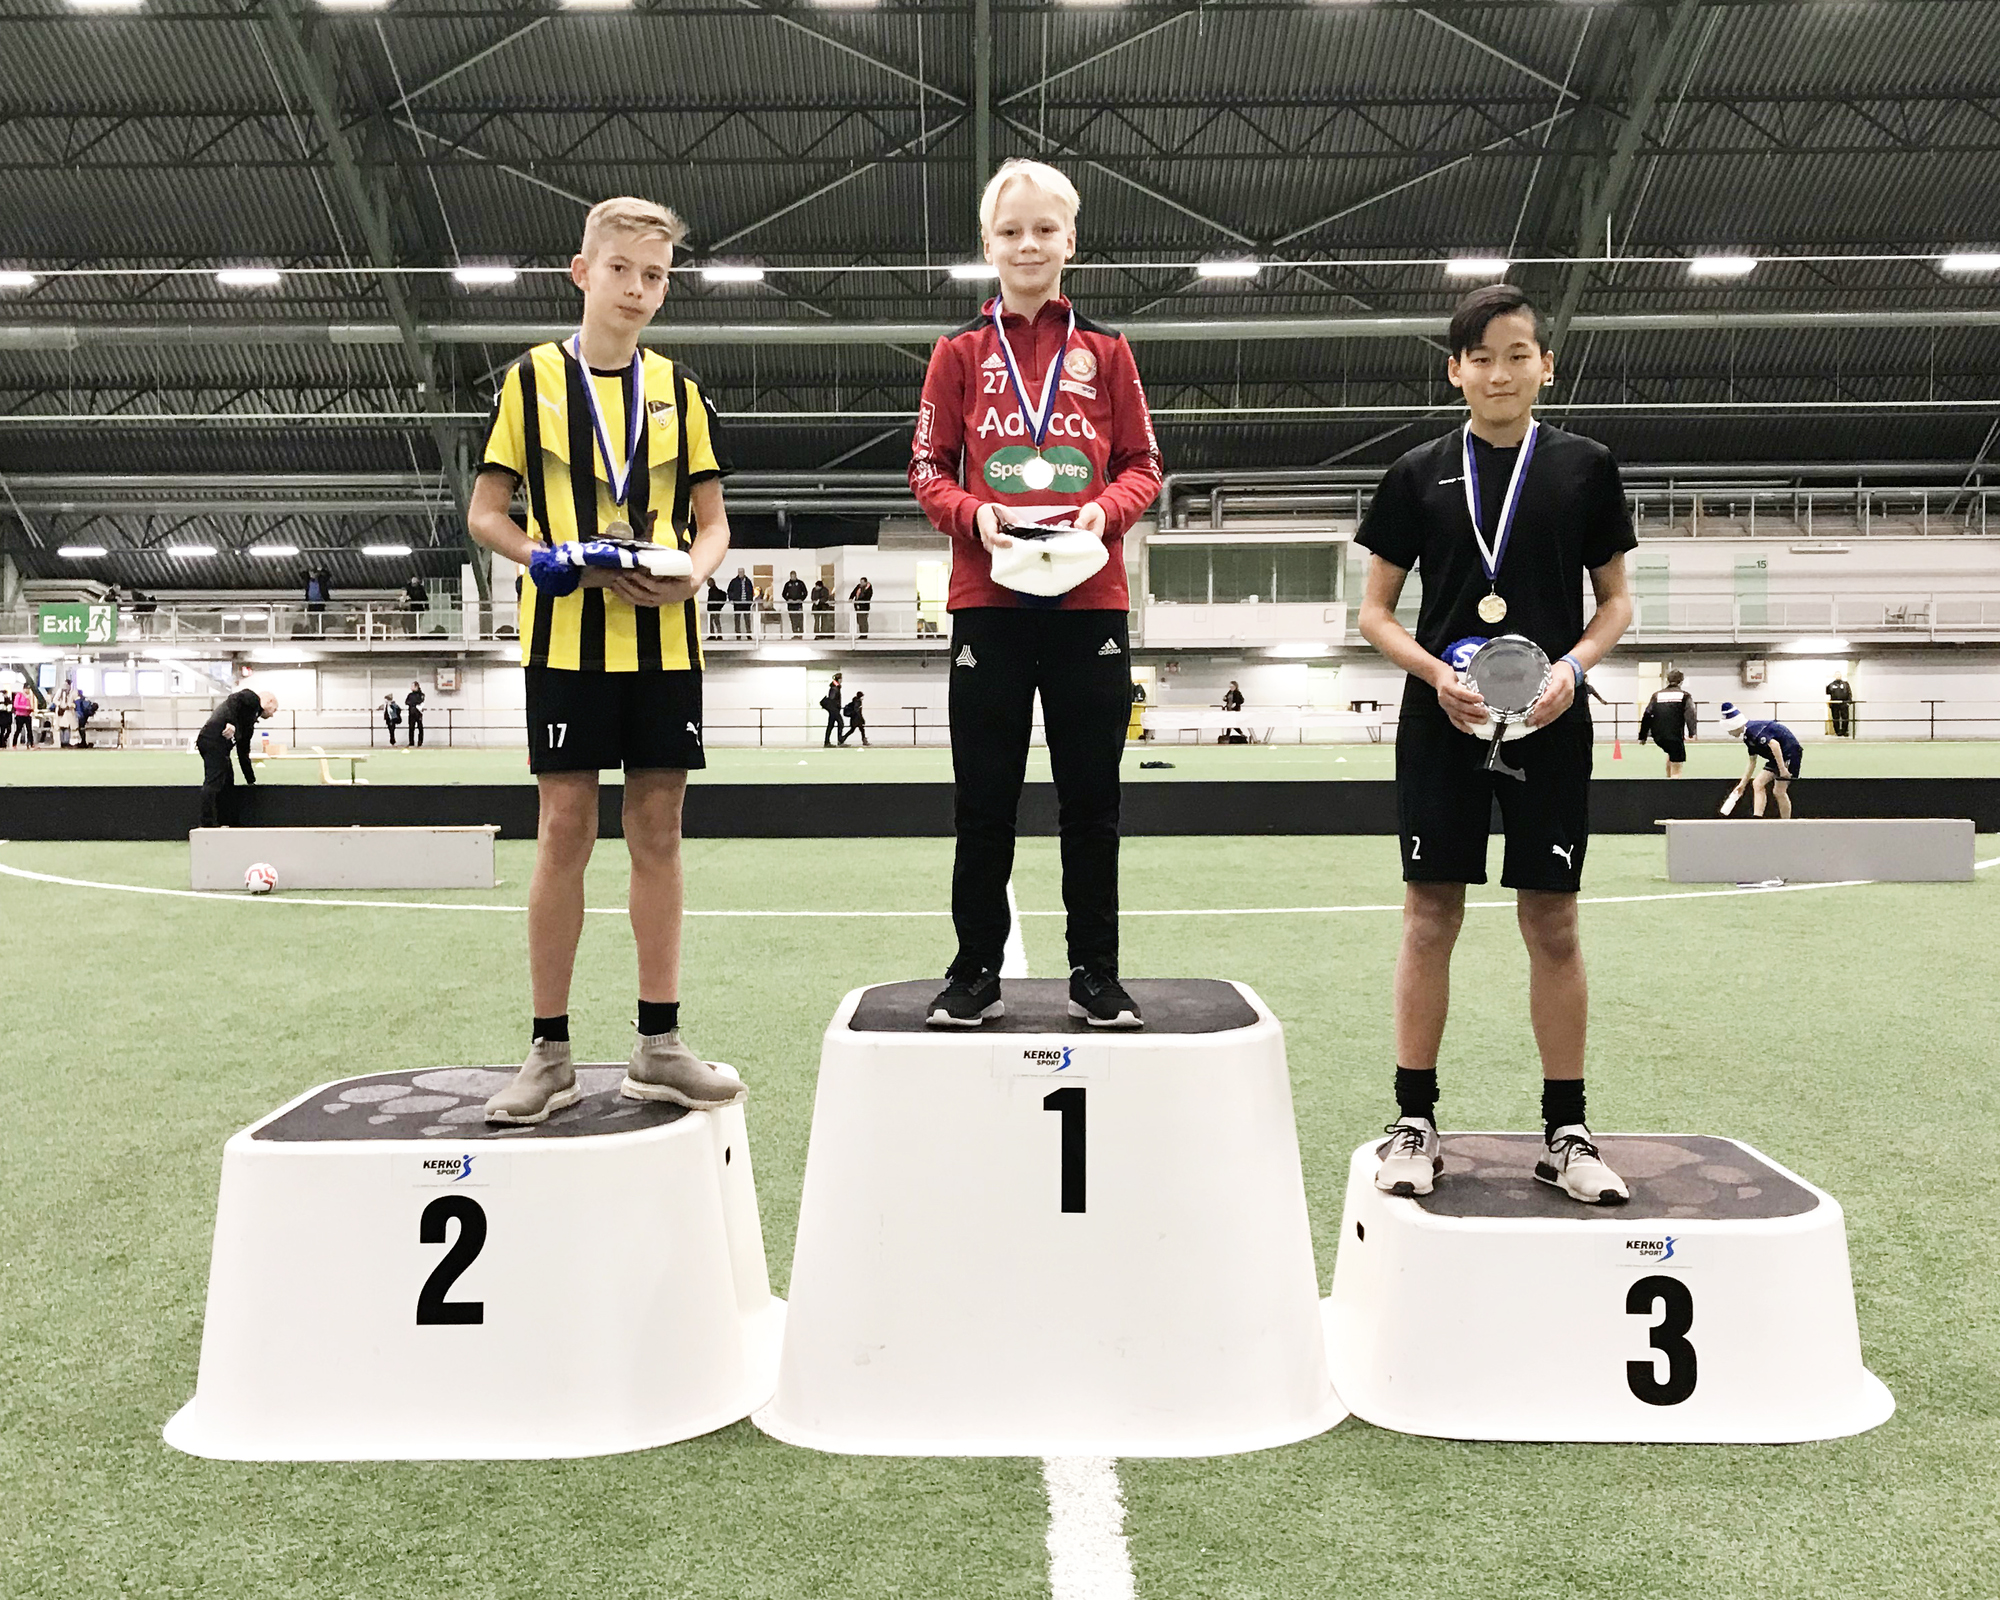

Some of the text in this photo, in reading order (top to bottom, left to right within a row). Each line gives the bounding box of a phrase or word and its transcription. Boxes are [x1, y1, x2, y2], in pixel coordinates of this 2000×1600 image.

[983, 370, 1009, 394] 27
[977, 406, 1097, 440] Adcco
[1756, 560, 1767, 569] 15
[43, 615, 82, 633] Exit
[1098, 648, 1121, 656] adidas
[547, 723, 568, 749] 17
[1411, 835, 1421, 860] 2
[1023, 1050, 1061, 1060] KERKO
[1043, 1087, 1087, 1213] 1
[423, 1160, 462, 1169] KERKO
[1626, 1240, 1664, 1250] KERKO
[416, 1195, 488, 1326] 2
[1626, 1275, 1698, 1406] 3
